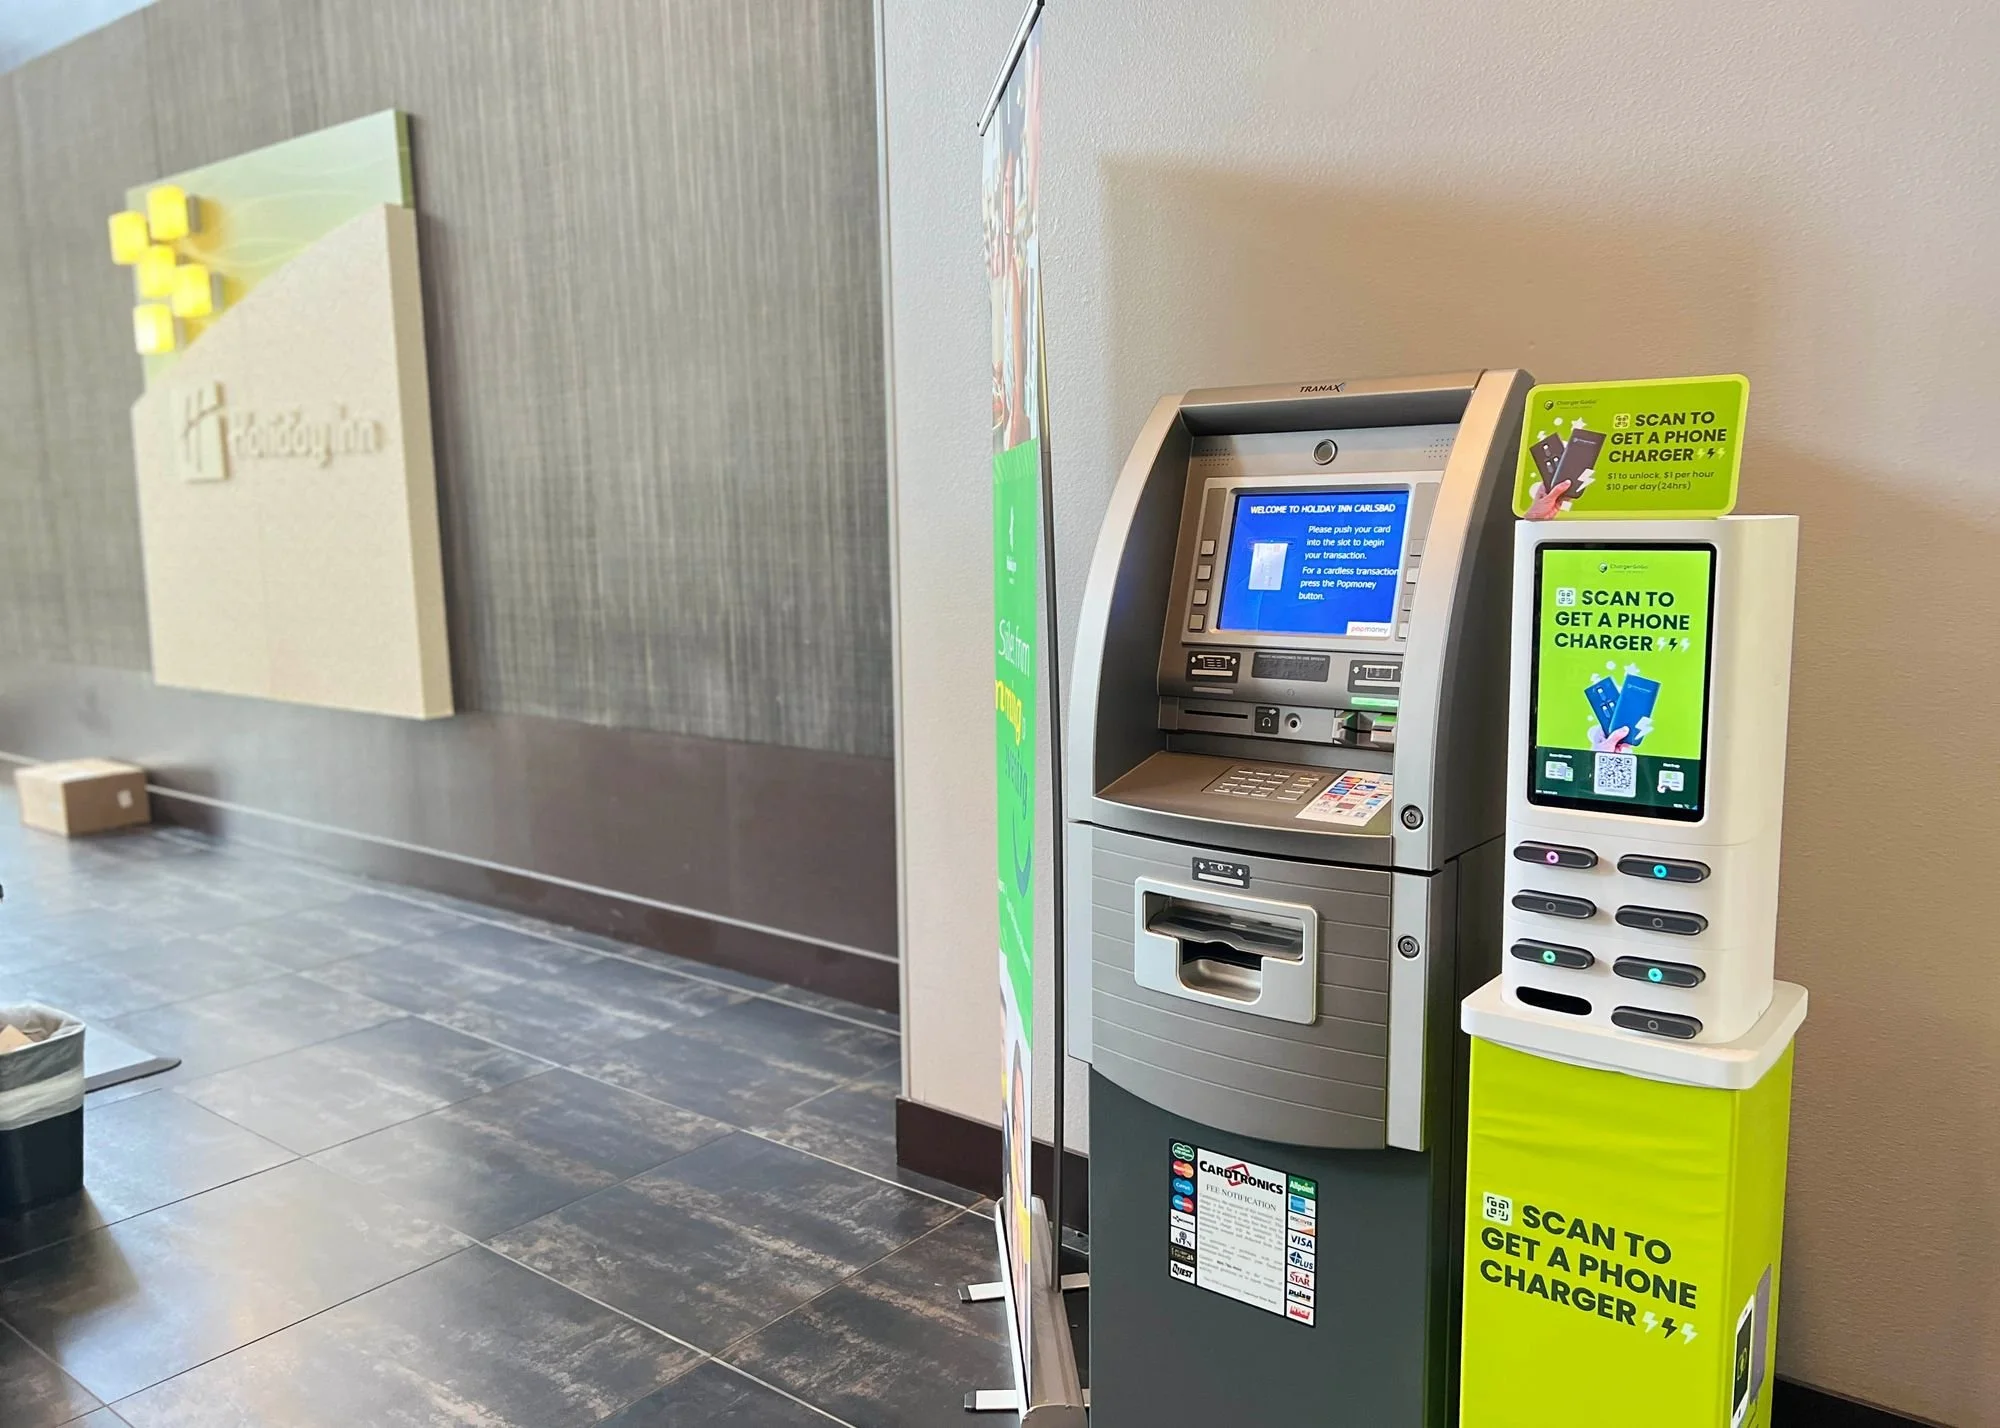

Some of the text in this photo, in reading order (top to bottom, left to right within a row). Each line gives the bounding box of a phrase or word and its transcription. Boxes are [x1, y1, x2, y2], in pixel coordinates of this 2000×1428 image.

[1300, 382, 1345, 392] TRANAX
[1635, 411, 1715, 427] SCAN TO
[1611, 431, 1644, 445] GET
[1647, 431, 1660, 444] A
[1664, 428, 1727, 443] PHONE
[1608, 448, 1693, 462] CHARGER
[1664, 471, 1673, 479] $1
[1674, 472, 1690, 480] per
[1692, 470, 1714, 479] hour
[1622, 483, 1638, 492] per
[1250, 506, 1287, 514] WELCOME
[1301, 505, 1335, 513] HOLIDAY
[1338, 504, 1352, 513] INN
[1354, 504, 1395, 512] CARLSBAD
[1308, 525, 1332, 533] Please
[1334, 526, 1352, 534] push
[1354, 526, 1372, 534] your
[1323, 538, 1335, 546] the
[1337, 538, 1351, 546] slot
[1363, 539, 1384, 547] begin
[1302, 567, 1314, 575] For
[1324, 567, 1354, 575] cardless
[1322, 580, 1335, 588] the
[1337, 580, 1376, 590] Popmoney
[1582, 590, 1674, 607] SCAN TO
[1555, 612, 1690, 630] GET A PHONE
[1351, 625, 1388, 634] popmoney
[1554, 633, 1653, 652] CHARGER
[1289, 1181, 1314, 1194] Allpoint
[1206, 1184, 1220, 1193] FEE
[1222, 1187, 1276, 1211] NOTIFICATION
[1522, 1205, 1672, 1264] SCAN TO
[1291, 1235, 1313, 1249] VISA
[1295, 1255, 1313, 1270] PLUS
[1481, 1227, 1697, 1309] GET A PHONE
[1289, 1272, 1310, 1287] STAR
[1480, 1259, 1637, 1326] CHARGER
